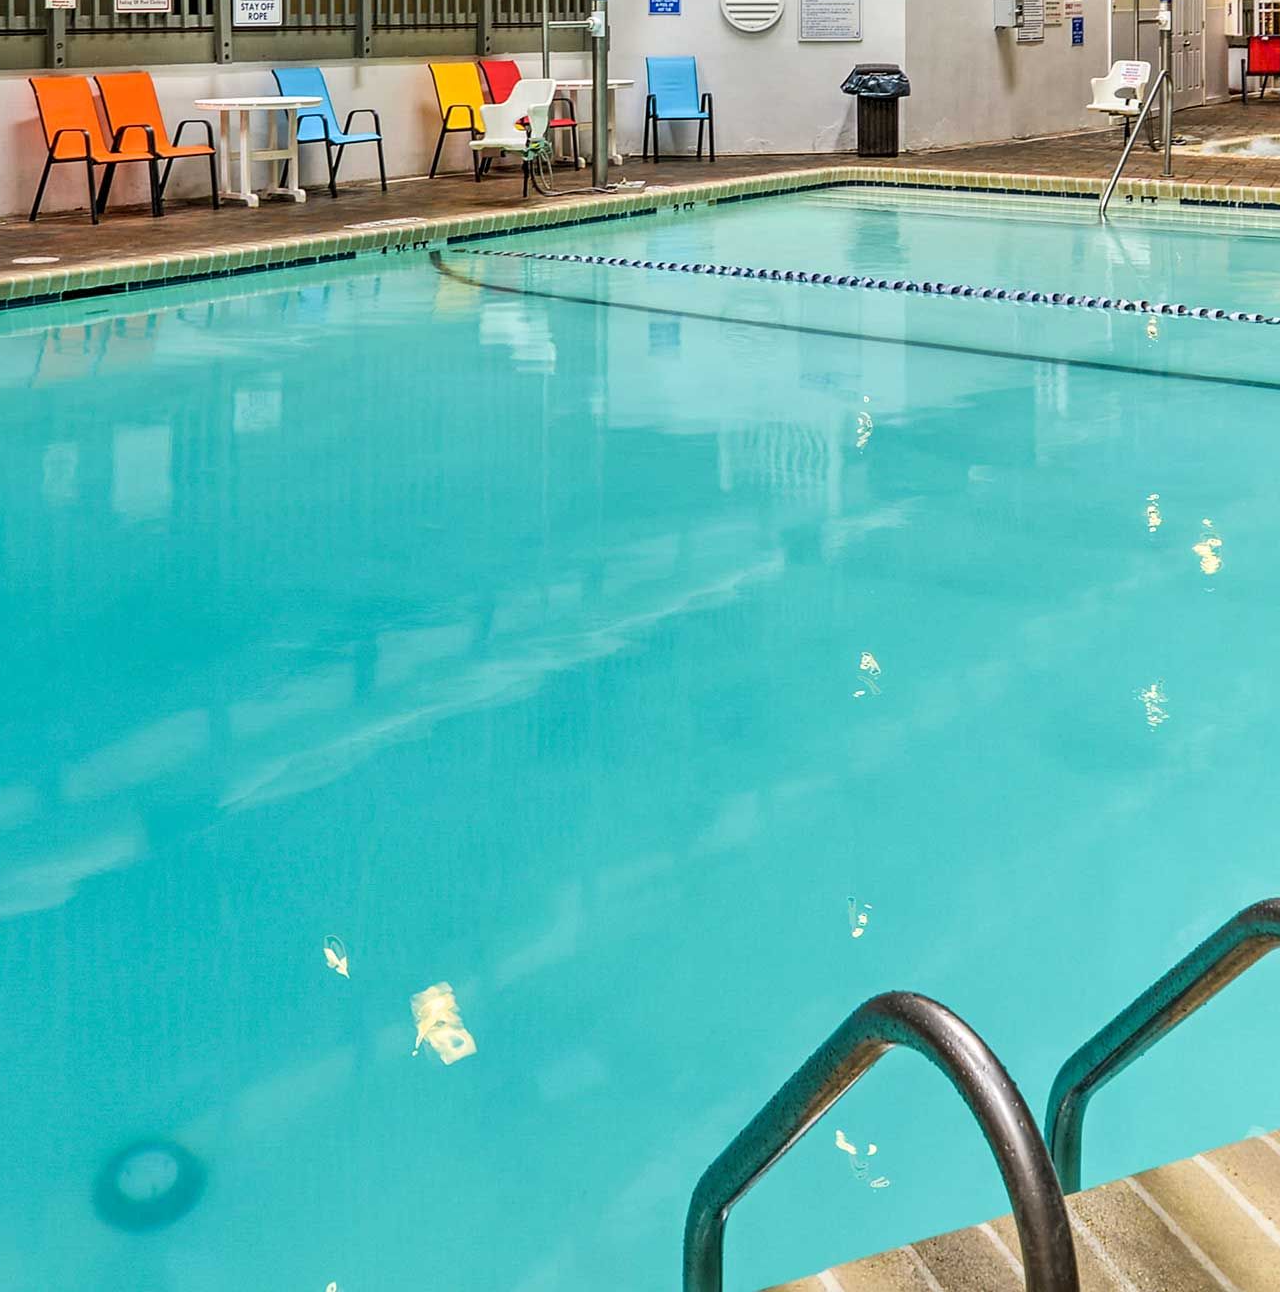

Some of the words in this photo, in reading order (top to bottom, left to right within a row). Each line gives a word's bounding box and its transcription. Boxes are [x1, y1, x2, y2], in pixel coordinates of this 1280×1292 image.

[241, 2, 259, 11] STAY
[260, 2, 275, 11] OFF
[248, 12, 268, 20] ROPE
